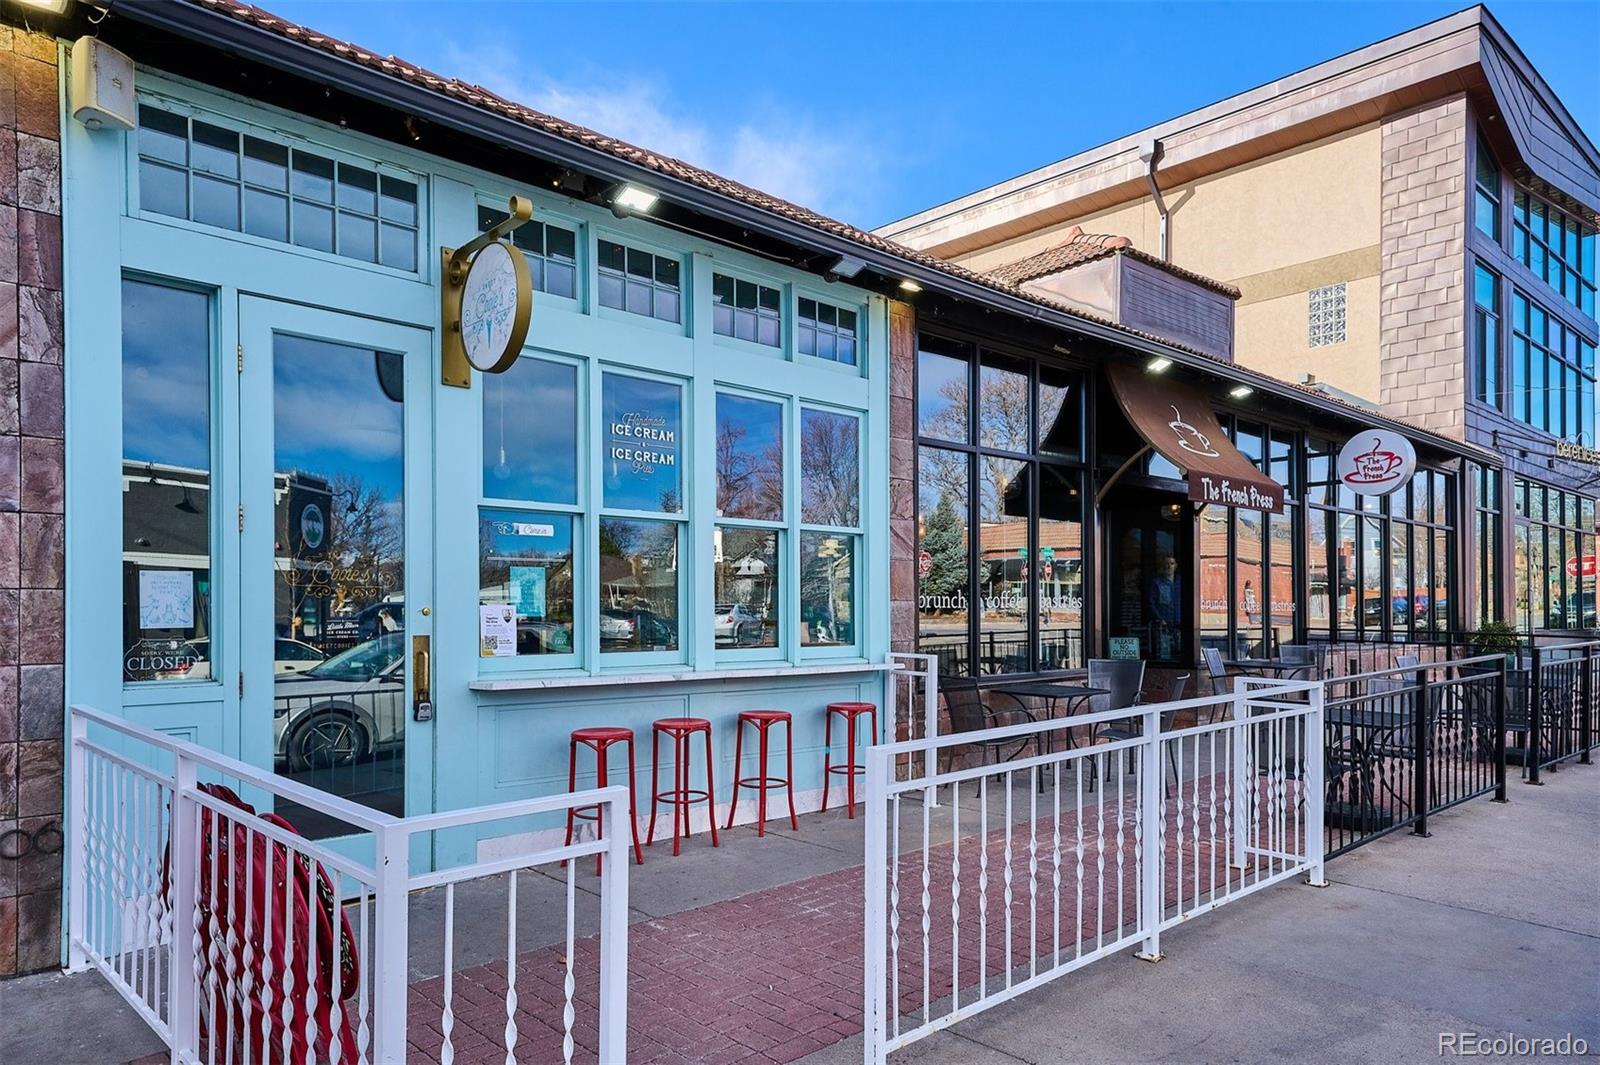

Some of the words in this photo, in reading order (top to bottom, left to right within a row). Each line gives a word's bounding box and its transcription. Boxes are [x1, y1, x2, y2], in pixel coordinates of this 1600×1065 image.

[622, 412, 666, 426] Handmade
[611, 423, 632, 436] ICE
[634, 426, 674, 442] CREAM
[611, 447, 632, 460] ICE
[634, 450, 674, 465] CREAM
[1363, 464, 1384, 472] French
[1364, 472, 1383, 480] Press
[1201, 477, 1220, 501] The
[1221, 479, 1249, 506] French
[1250, 485, 1274, 509] Press
[918, 589, 967, 609] brunch
[1040, 593, 1083, 610] pastries
[126, 655, 198, 672] CLOSED
